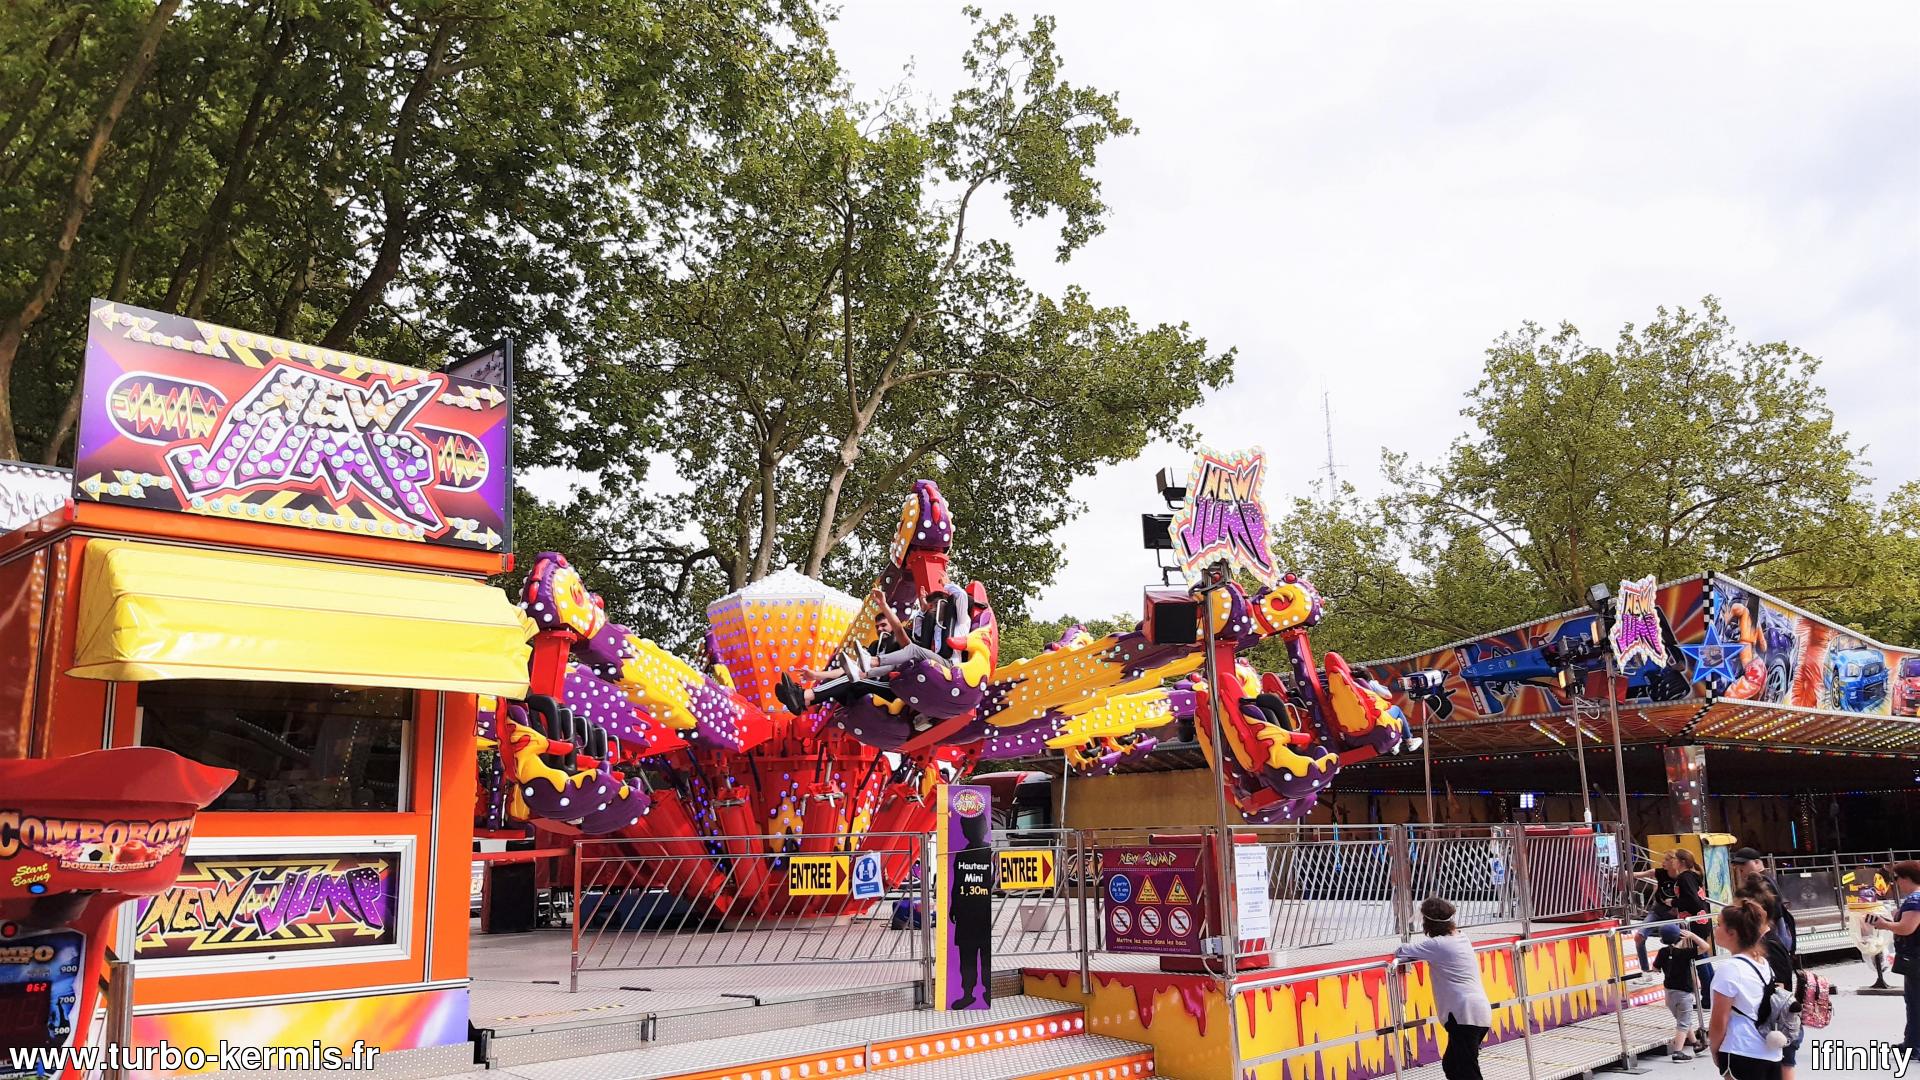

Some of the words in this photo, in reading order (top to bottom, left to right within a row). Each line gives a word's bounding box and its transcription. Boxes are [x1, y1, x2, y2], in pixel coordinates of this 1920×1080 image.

[246, 367, 437, 432] NEW
[170, 410, 440, 528] JUMP
[1200, 463, 1258, 503] NEW
[1181, 496, 1270, 570] JUMP
[1623, 589, 1652, 615] NEW
[1615, 613, 1662, 655] JUMP
[16, 863, 49, 877] Start
[61, 860, 110, 871] DOUBLE
[111, 860, 157, 872] COMBAT
[790, 862, 832, 889] ENTREE
[958, 861, 990, 871] Hauteur
[964, 873, 984, 883] Mini
[1001, 857, 1038, 883] ENTREE
[11, 872, 51, 887] Boxing
[960, 885, 989, 896] 1,30m
[137, 871, 260, 936] NEW
[255, 867, 385, 937] JUMP
[60, 996, 76, 1004] 700
[54, 1027, 70, 1035] 500
